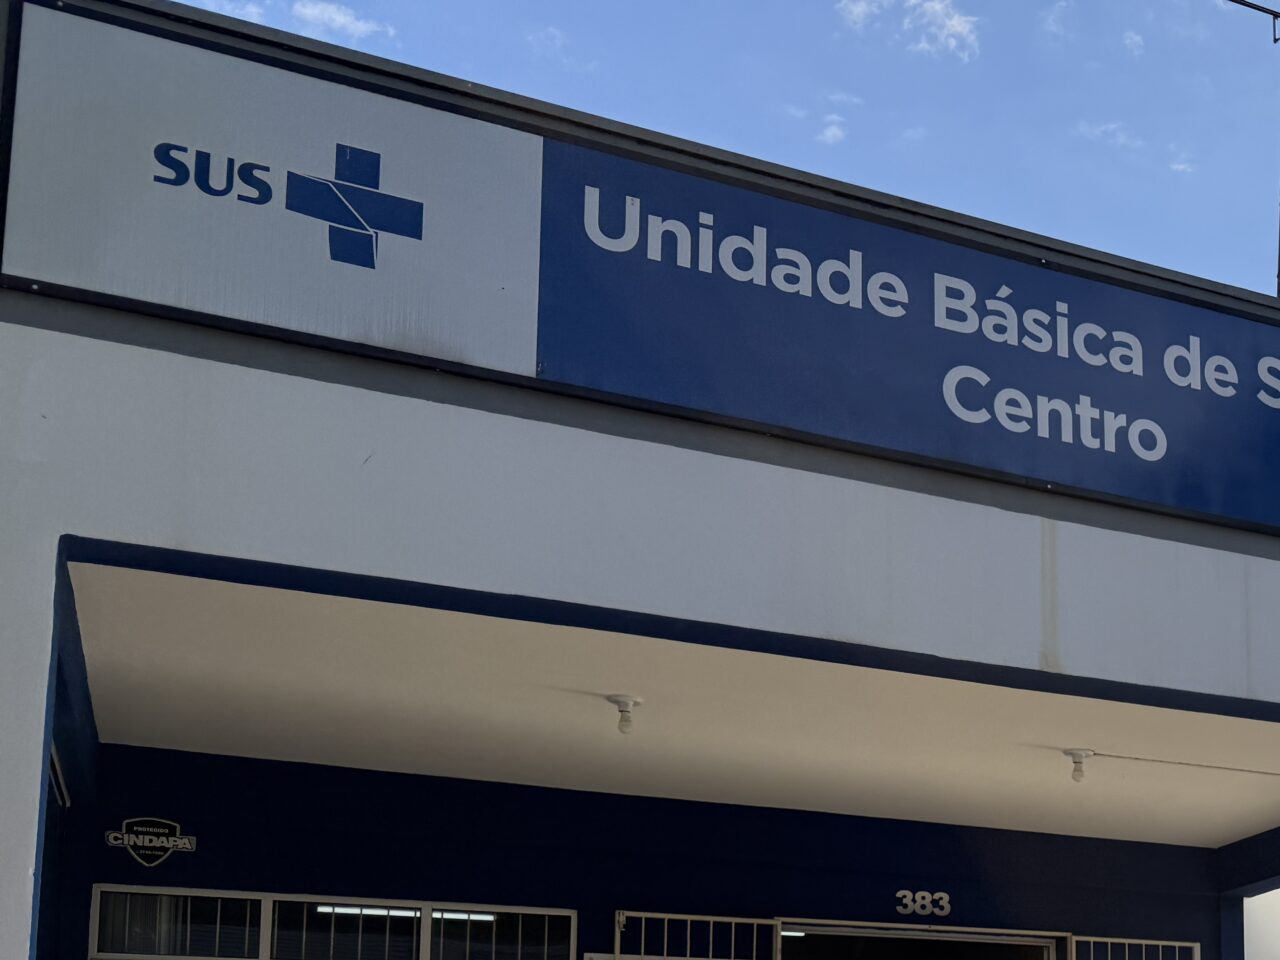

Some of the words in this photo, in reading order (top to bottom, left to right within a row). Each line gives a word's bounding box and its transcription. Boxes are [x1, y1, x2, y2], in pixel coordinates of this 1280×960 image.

[153, 142, 272, 205] SUS
[583, 185, 909, 318] Unidade
[934, 273, 1144, 376] Básica
[1163, 335, 1239, 398] de
[942, 365, 1168, 462] Centro
[108, 832, 193, 850] CINDAPA
[895, 889, 952, 917] 383
